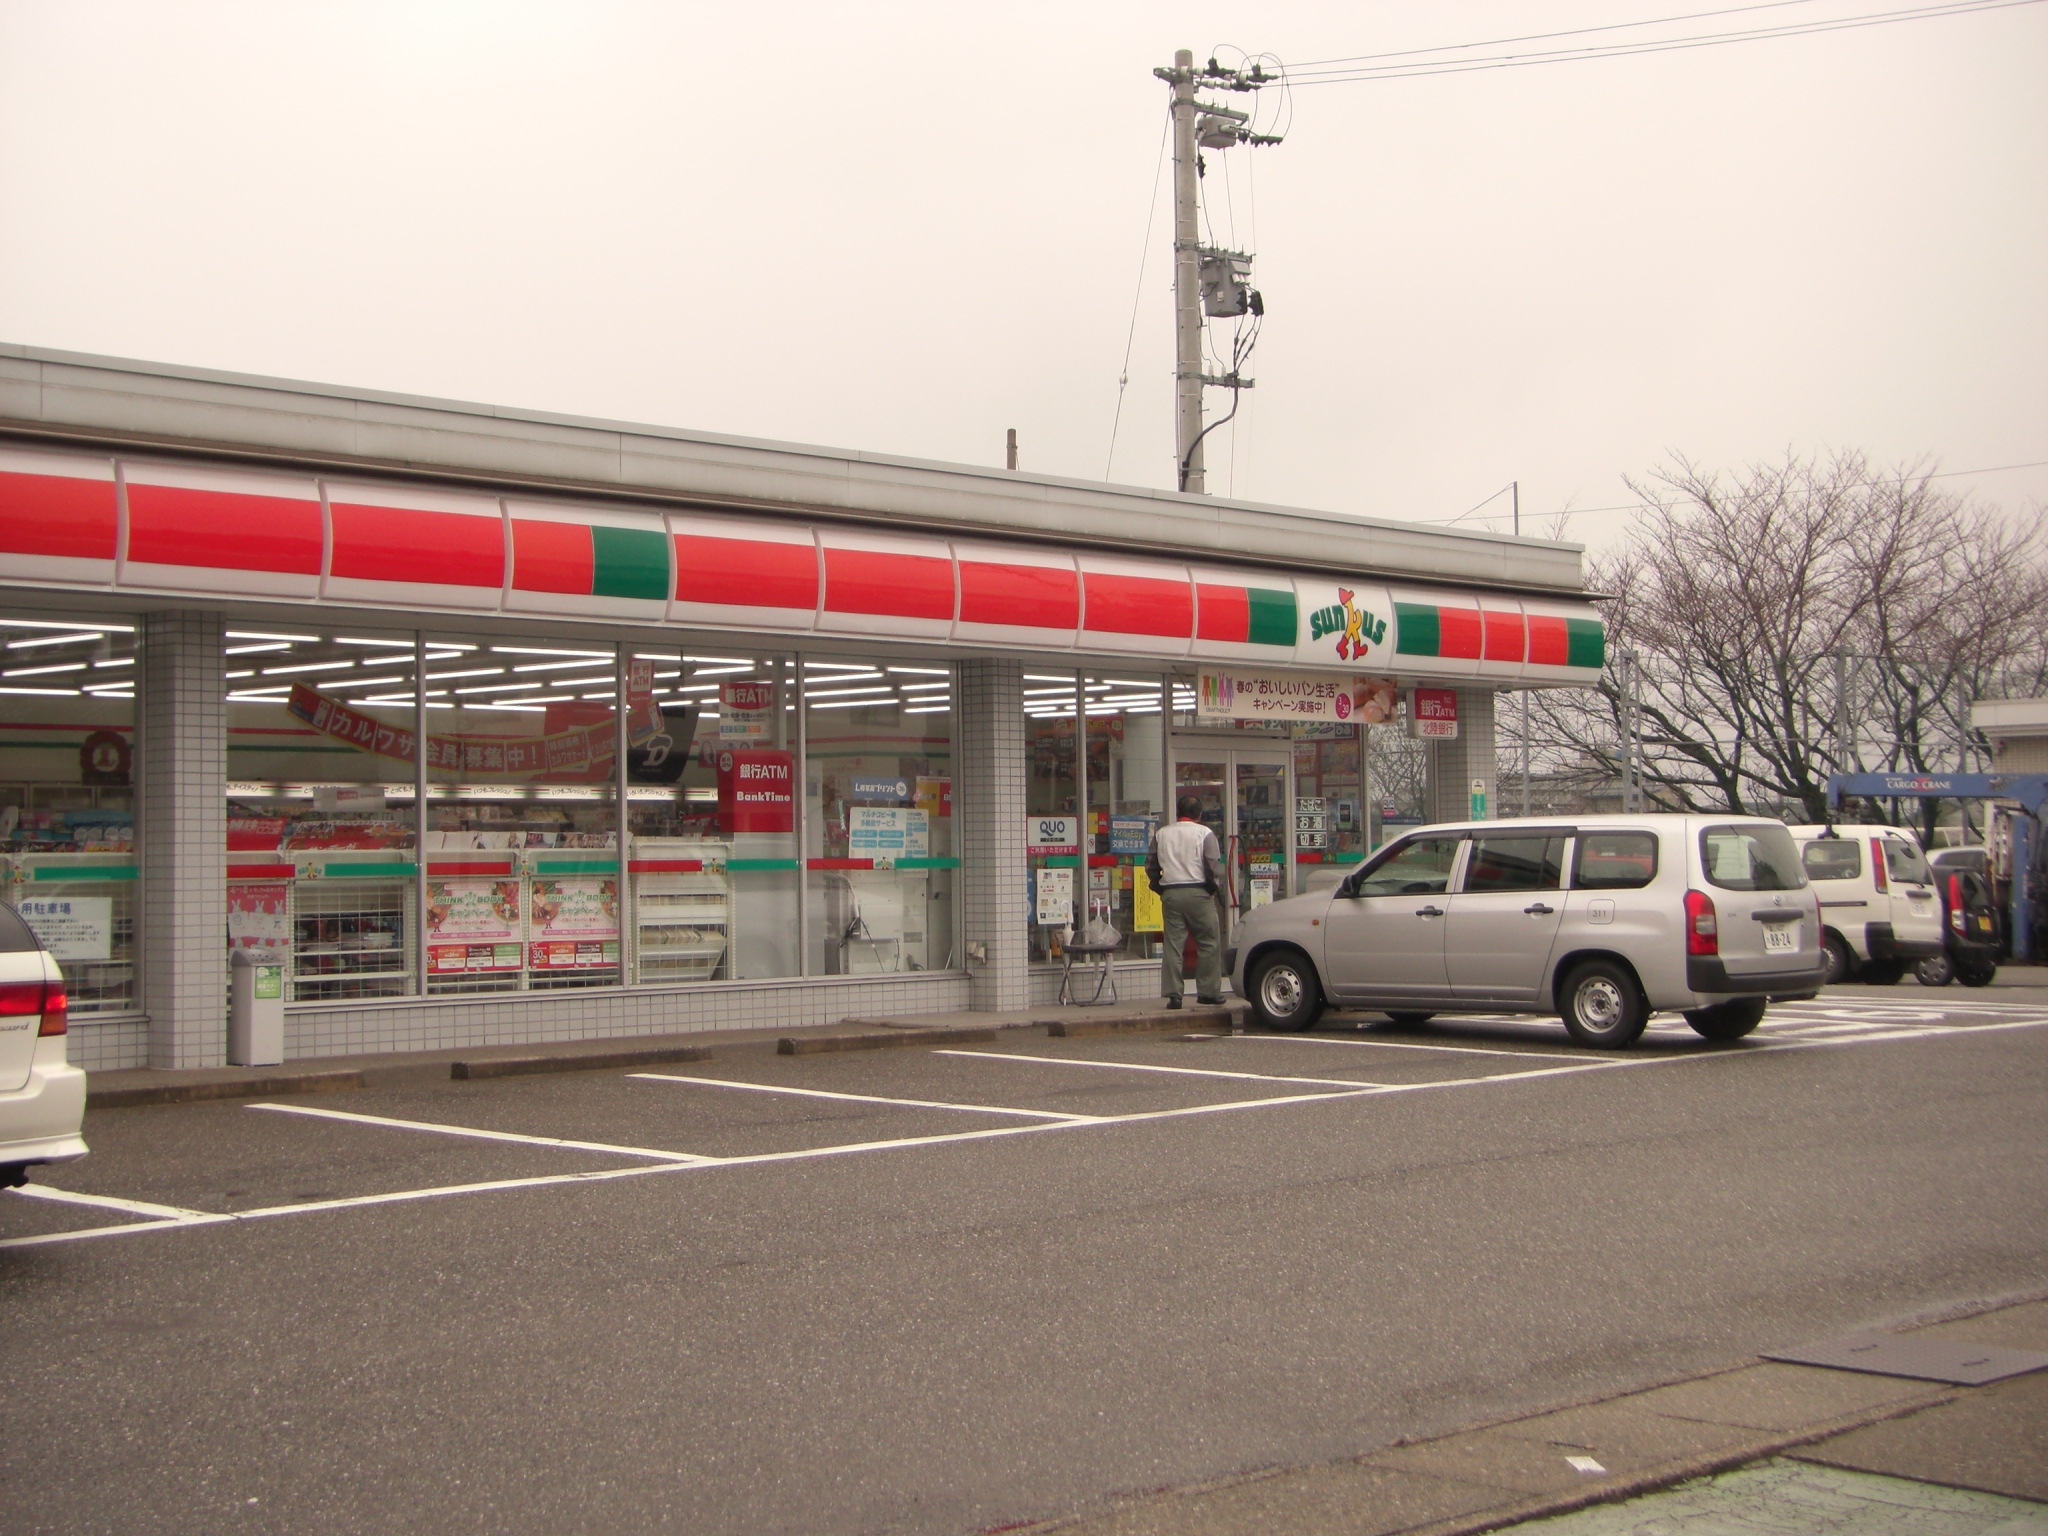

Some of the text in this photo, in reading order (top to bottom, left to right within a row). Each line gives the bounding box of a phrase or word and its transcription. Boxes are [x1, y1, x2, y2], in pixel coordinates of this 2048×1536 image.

[633, 676, 649, 686] ATM
[1253, 698, 1326, 714] キャンペーン実施中！
[740, 764, 788, 779] 銀行ATM
[1887, 781, 1951, 789] CARGO CRANE
[737, 791, 791, 802] BankTime
[1299, 800, 1322, 811] たばこ
[1040, 820, 1065, 836] QUO
[1300, 833, 1322, 846] 切手
[434, 895, 505, 905] THINK BODY
[545, 893, 613, 903] THINK BODY
[1592, 910, 1607, 918] 311
[1769, 933, 1792, 947] 88-24
